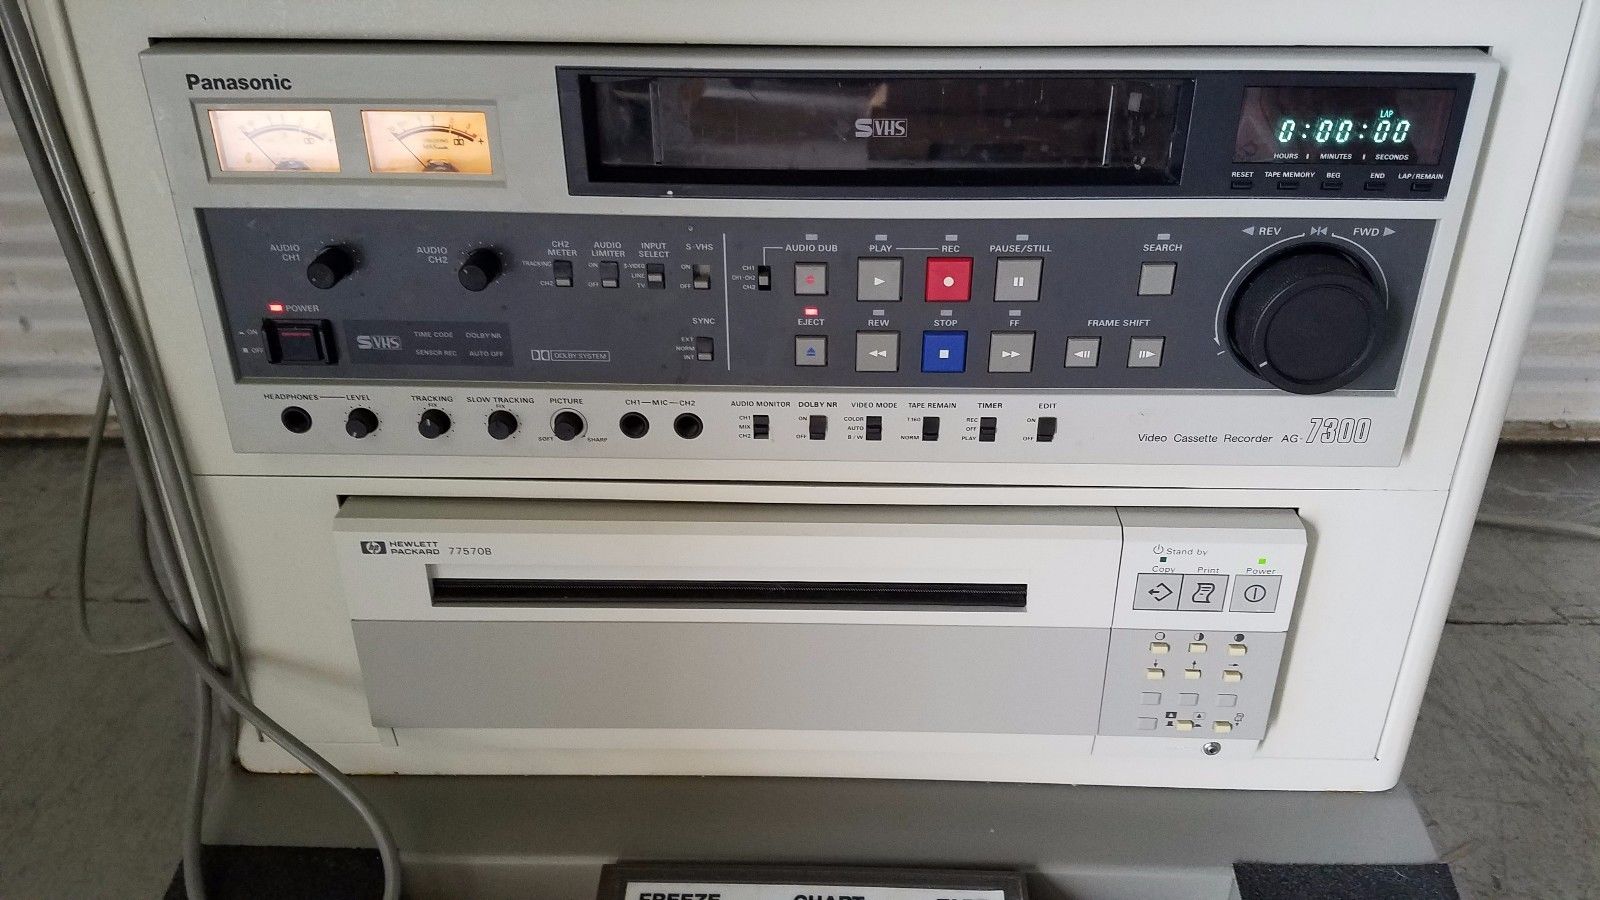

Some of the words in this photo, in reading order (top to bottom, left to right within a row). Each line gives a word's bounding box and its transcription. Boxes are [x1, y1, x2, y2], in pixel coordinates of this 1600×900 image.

[186, 73, 293, 91] Panasonic
[1380, 110, 1394, 118] LAP
[1278, 119, 1411, 143] 0:00:00
[1258, 227, 1282, 236] REV
[1353, 228, 1379, 237] FWD
[270, 244, 300, 252] AUDIO
[551, 240, 570, 248] CH2
[593, 241, 622, 249] AUDIO
[640, 242, 667, 250] INPUT
[785, 244, 815, 252] AUDIO
[818, 244, 838, 252] DUB
[1142, 244, 1183, 252] SEARCH
[416, 246, 448, 255] AUDIO
[869, 244, 893, 253] PLAY
[941, 245, 960, 253] REC
[989, 244, 1052, 253] PAUSE/STILL
[547, 249, 578, 257] METER
[591, 250, 626, 258] LIMITER
[282, 253, 300, 262] CH1
[428, 255, 448, 264] CH2
[285, 304, 319, 313] POWER
[692, 317, 716, 325] SYNC
[797, 318, 825, 326] EJECT
[868, 319, 890, 327] REW
[933, 319, 958, 328] STOP
[1009, 319, 1020, 327] FF
[1087, 319, 1121, 327] FRAME
[1122, 319, 1151, 327] SHIFT
[246, 328, 258, 336] ON
[413, 330, 432, 338] TIME
[433, 330, 454, 339] CODE
[465, 331, 489, 339] DOLBY
[415, 349, 443, 357] SENSOR
[469, 350, 489, 358] AUTO
[263, 393, 319, 401] HEADPHONES
[411, 395, 454, 403] TRACKING
[492, 397, 535, 405] TRACKING
[549, 397, 584, 405] PICTURE
[625, 399, 642, 407] CH1
[652, 399, 669, 407] MIC
[679, 399, 696, 407] CH2
[730, 400, 755, 408] AUDIO
[756, 400, 791, 408] MONITOR
[798, 401, 825, 409] DOLBY
[826, 401, 838, 409] NR
[875, 402, 898, 410] MODE
[977, 402, 1003, 410] TIMER
[1038, 402, 1057, 410] EDIT
[1138, 433, 1168, 443] Video
[1173, 433, 1218, 443] Cassette
[1223, 433, 1273, 443] Recorder
[448, 547, 492, 556] 77570B
[1166, 547, 1193, 556] Stand
[1196, 548, 1208, 556] by
[1152, 565, 1175, 573] Copy
[1197, 566, 1220, 574] Print
[1246, 567, 1276, 575] Power
